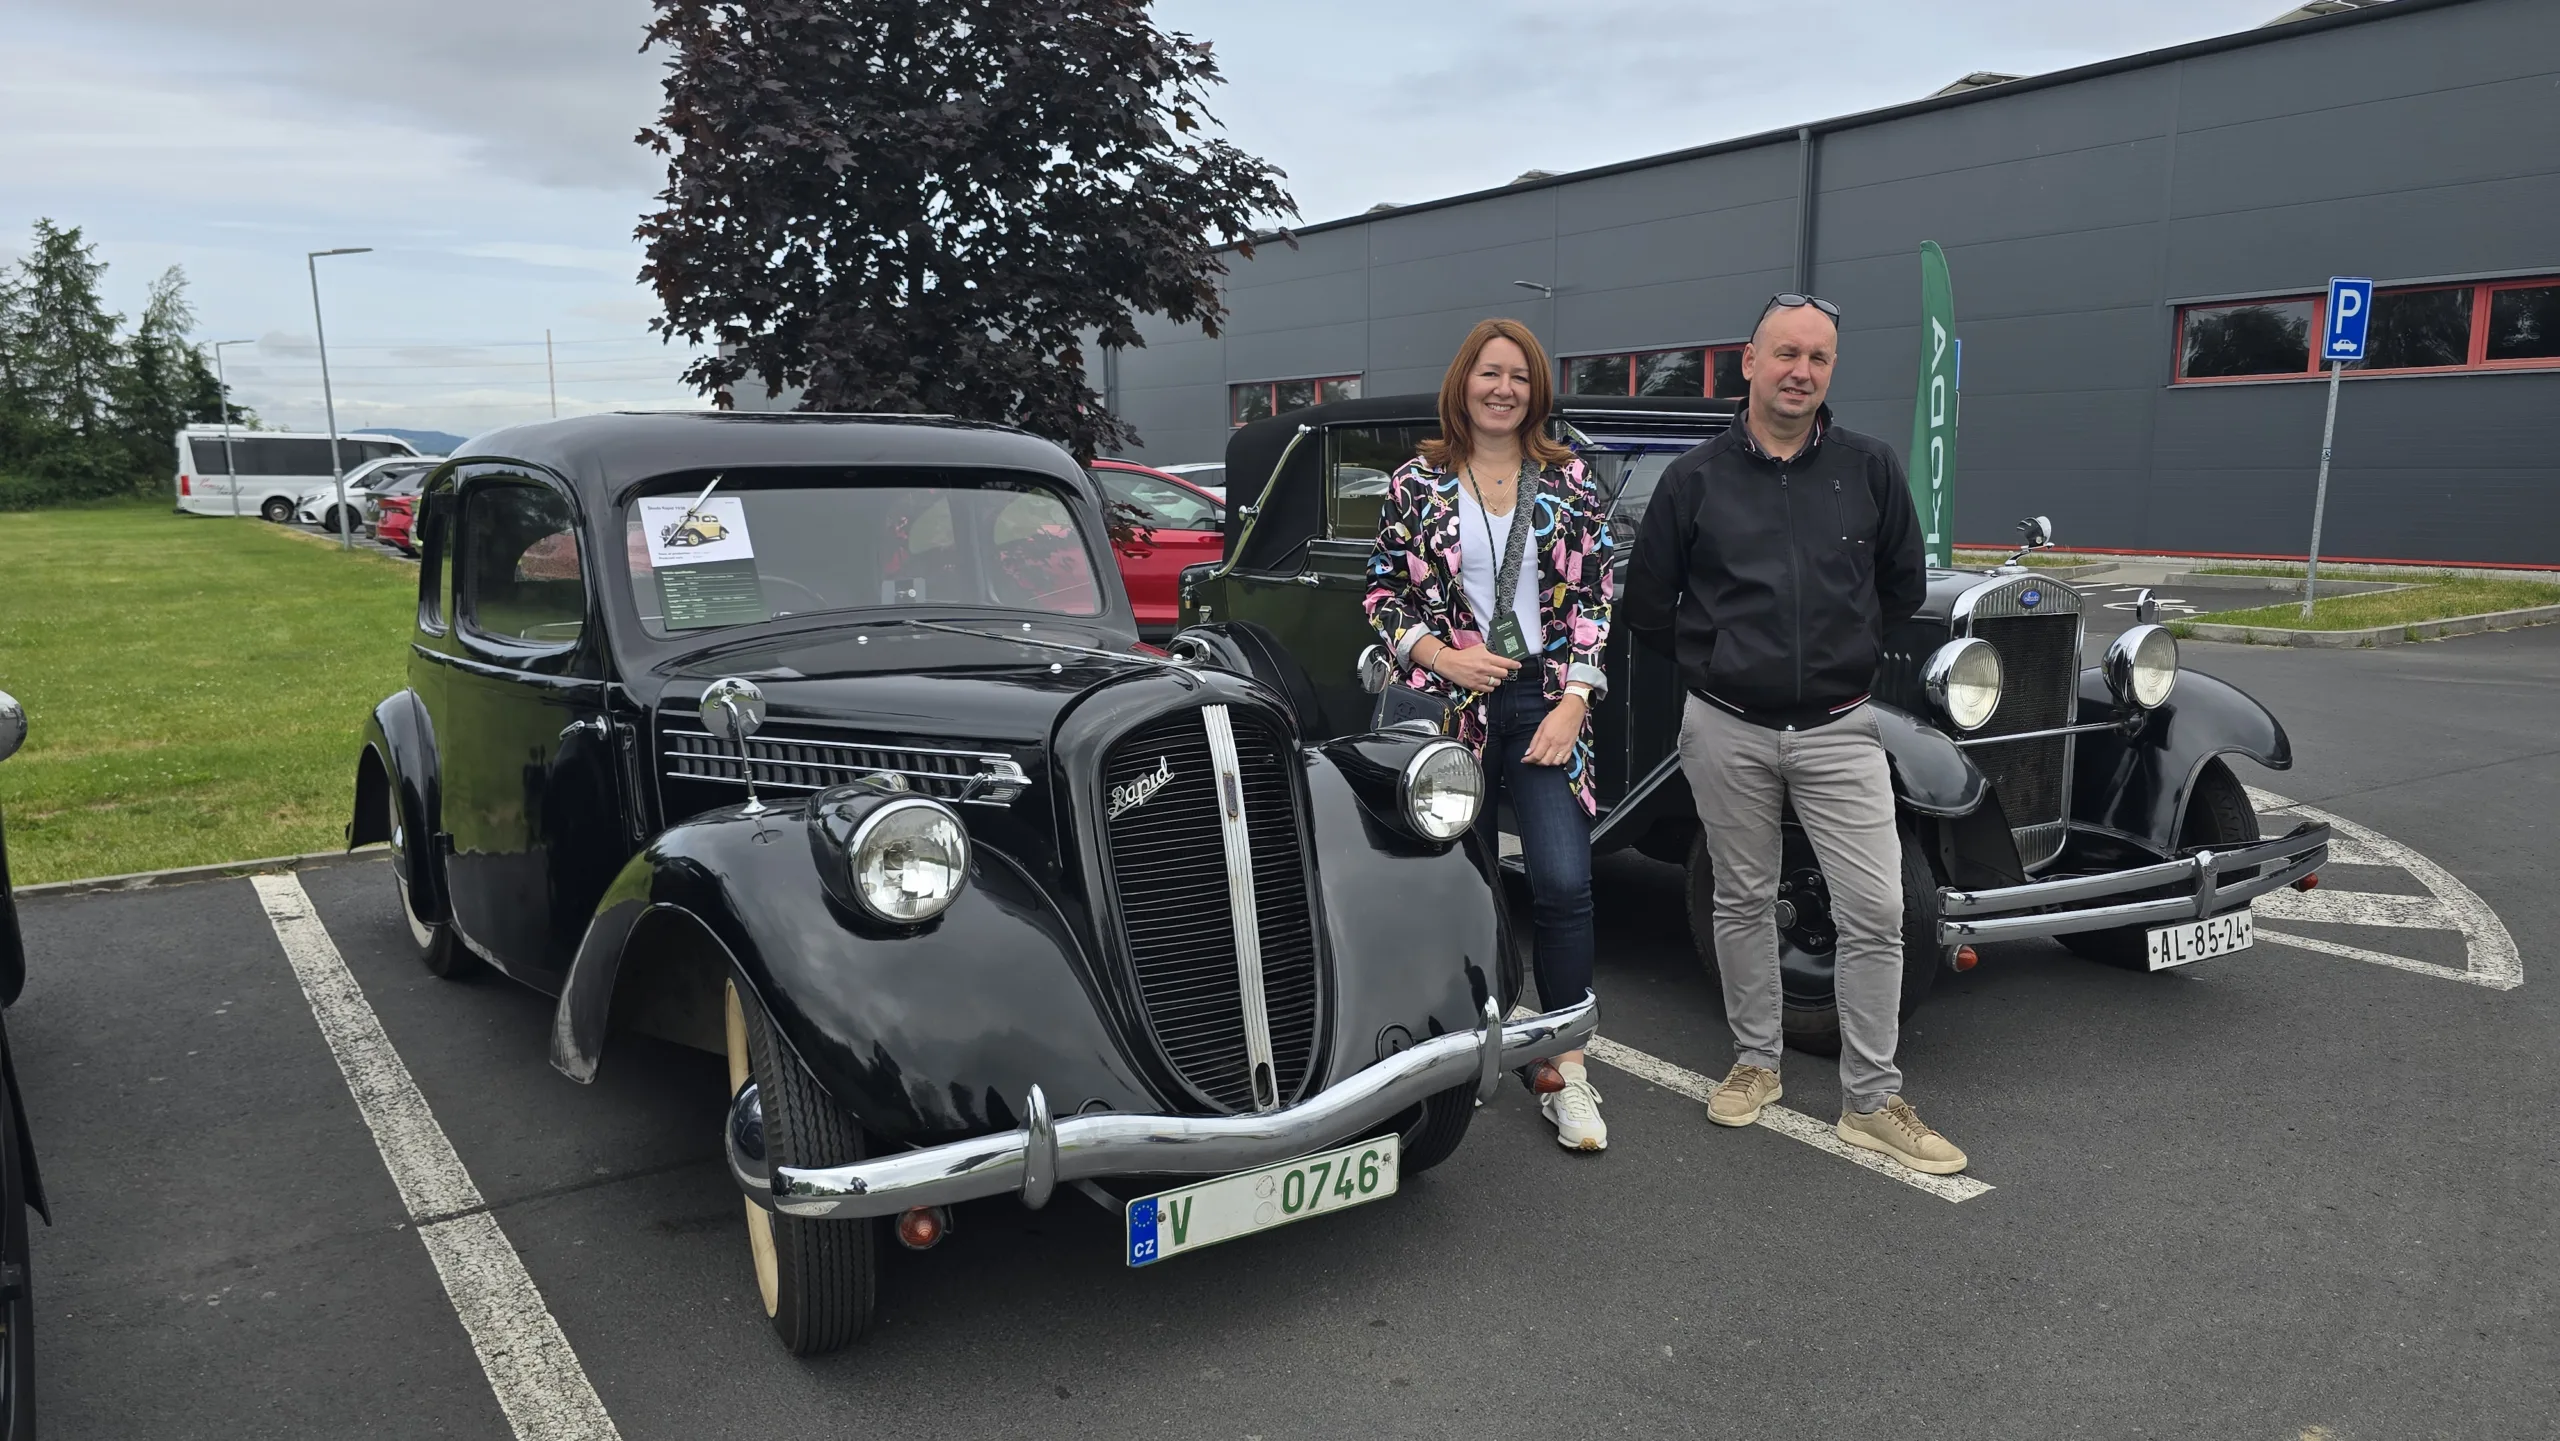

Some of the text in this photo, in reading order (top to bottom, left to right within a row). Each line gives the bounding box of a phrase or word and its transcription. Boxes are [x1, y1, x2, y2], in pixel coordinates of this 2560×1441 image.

[2336, 289, 2361, 334] P
[1108, 755, 1175, 819] Rapid
[2161, 916, 2245, 963] AL-85-24
[1169, 1149, 1379, 1246] V 0746
[1134, 1239, 1155, 1258] CZ
